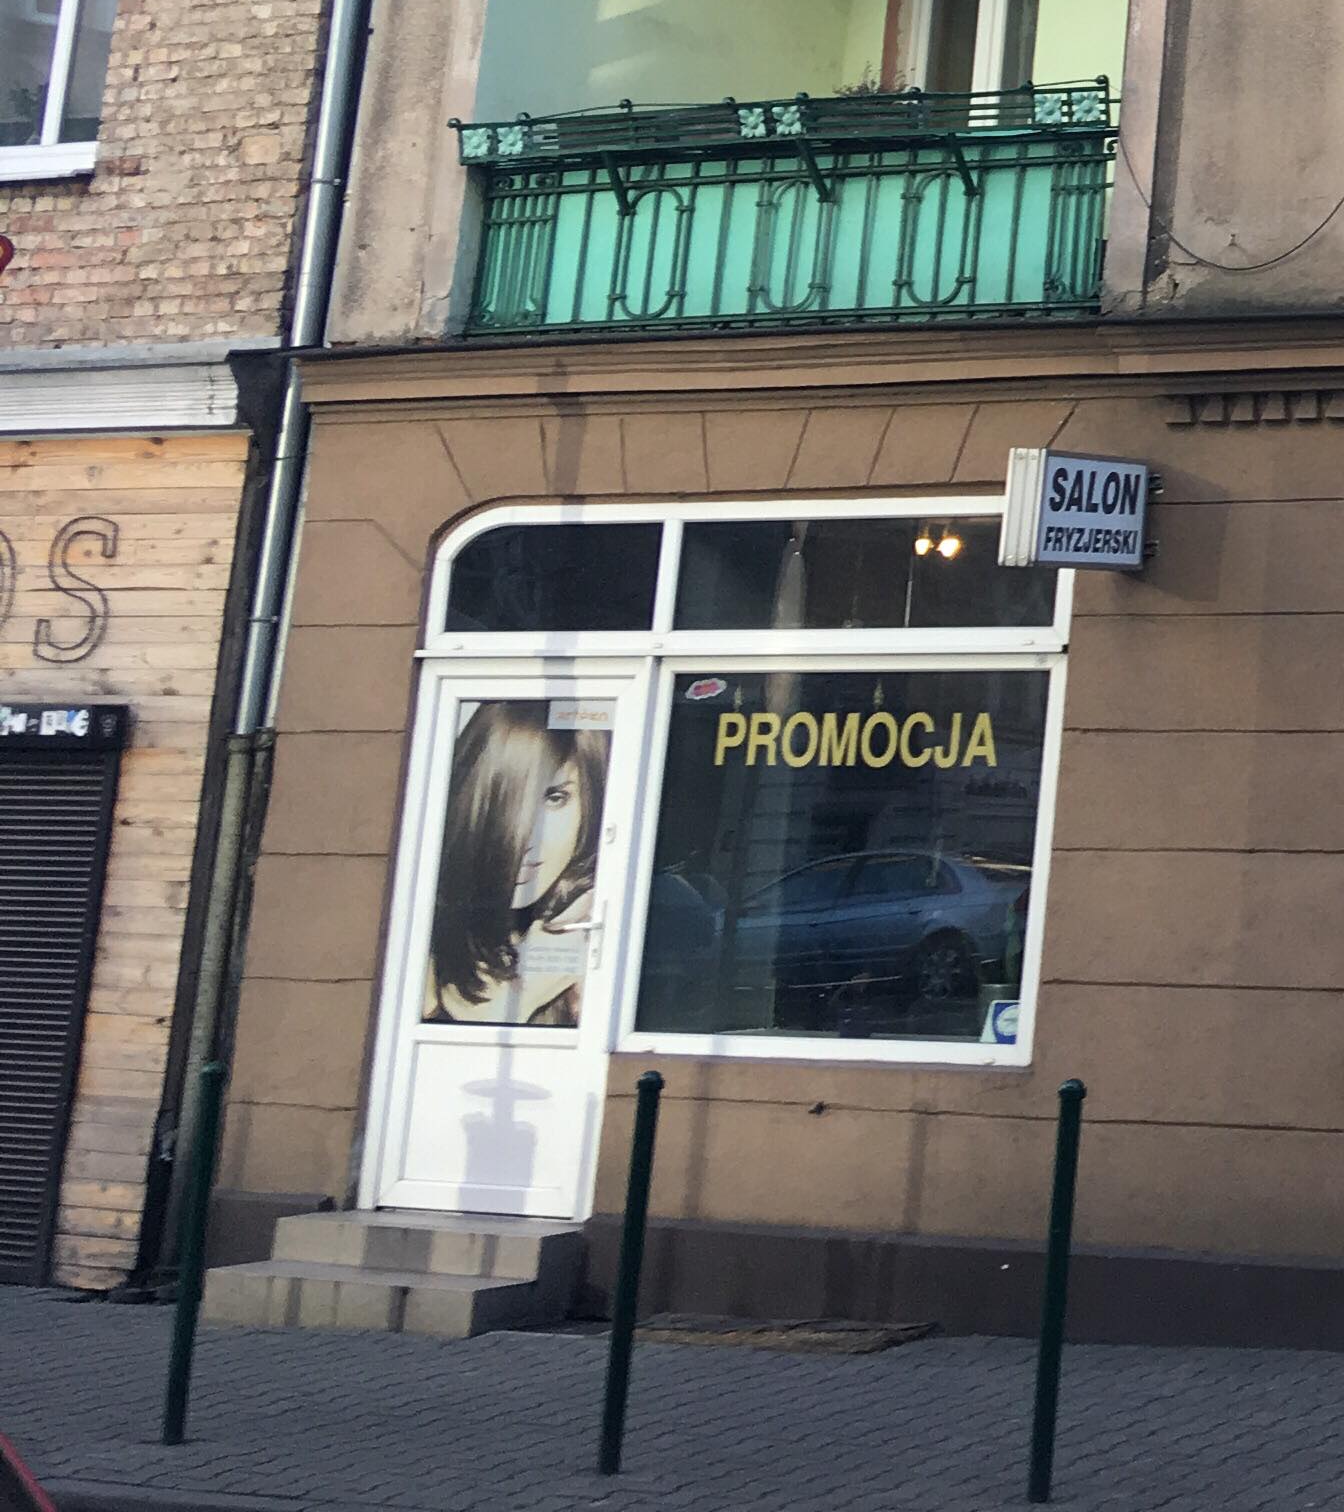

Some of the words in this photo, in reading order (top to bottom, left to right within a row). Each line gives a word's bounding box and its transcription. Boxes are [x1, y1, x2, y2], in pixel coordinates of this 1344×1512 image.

[1050, 467, 1141, 515] SALON
[1043, 526, 1139, 555] FRYZJERSKI
[0, 516, 119, 664] S
[714, 711, 998, 769] PROMOCJA
